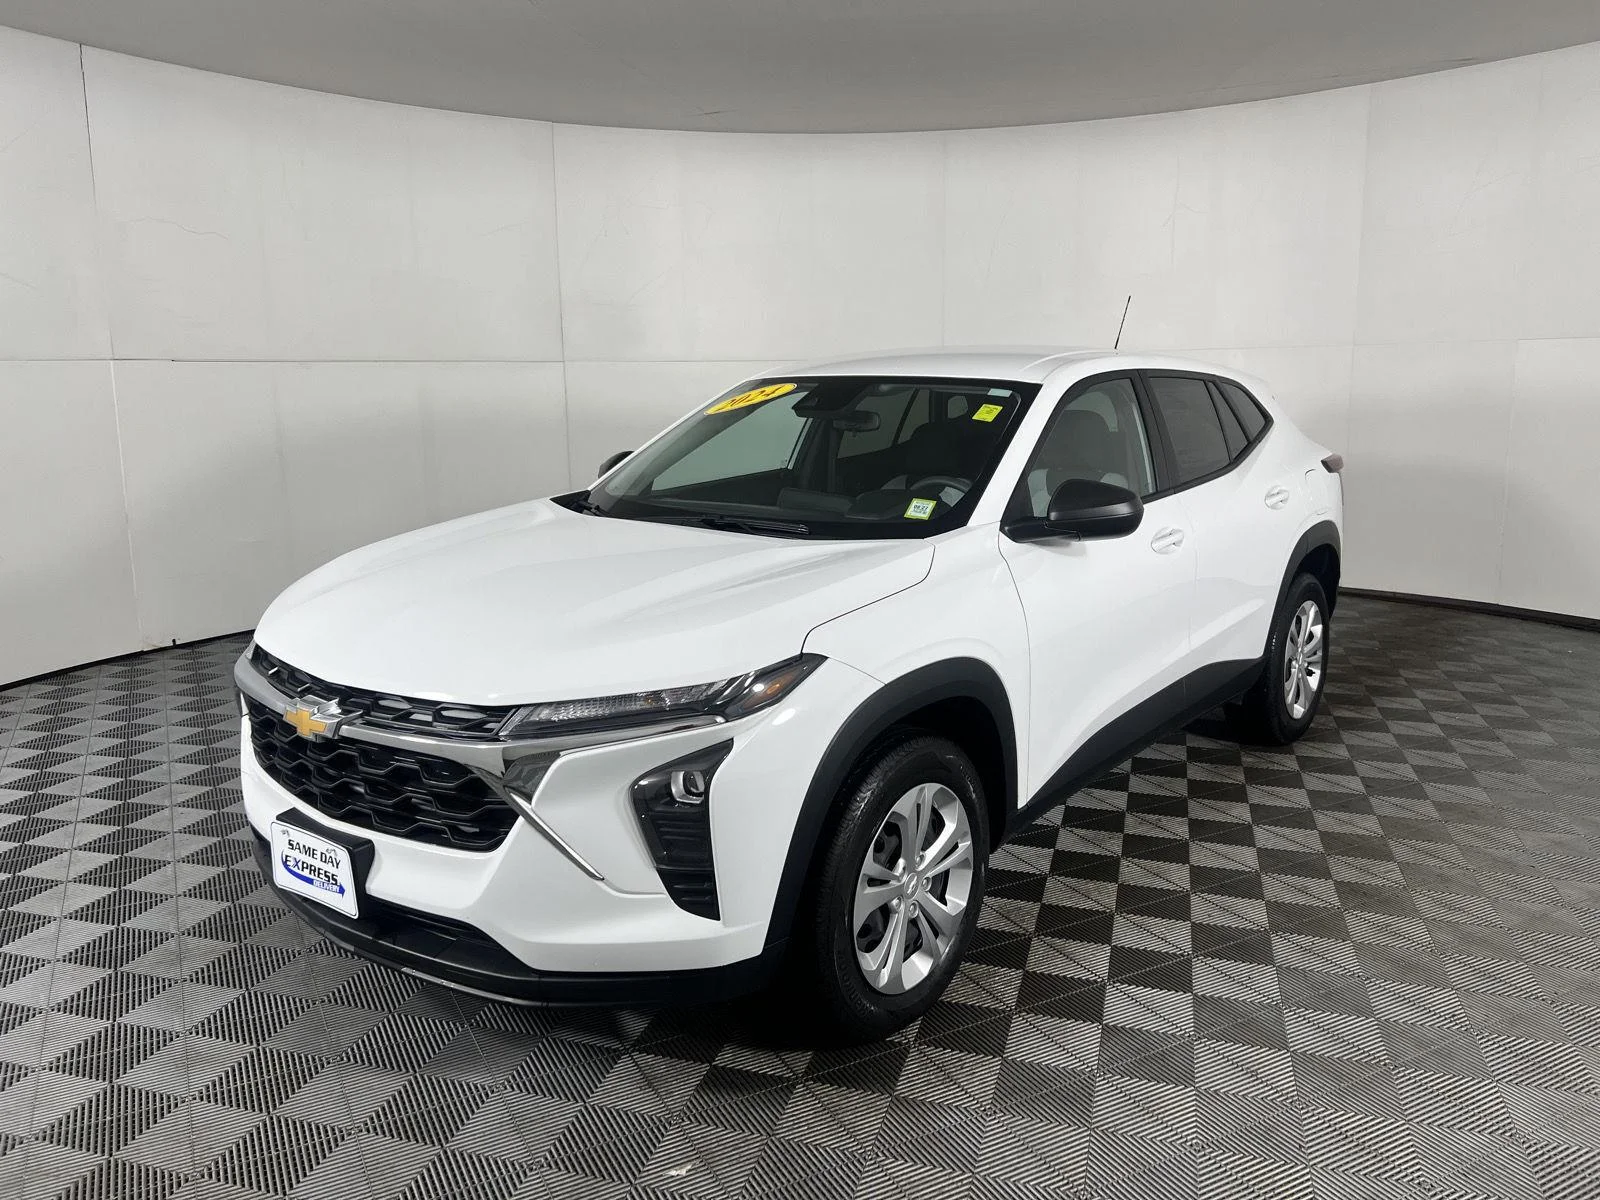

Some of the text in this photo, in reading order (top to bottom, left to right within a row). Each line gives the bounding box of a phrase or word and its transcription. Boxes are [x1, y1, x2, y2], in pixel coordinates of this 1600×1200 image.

[712, 384, 785, 411] 2024
[288, 839, 341, 869] SAME DAY
[285, 854, 338, 886] EXPRESS
[313, 879, 340, 893] DELIVERY
